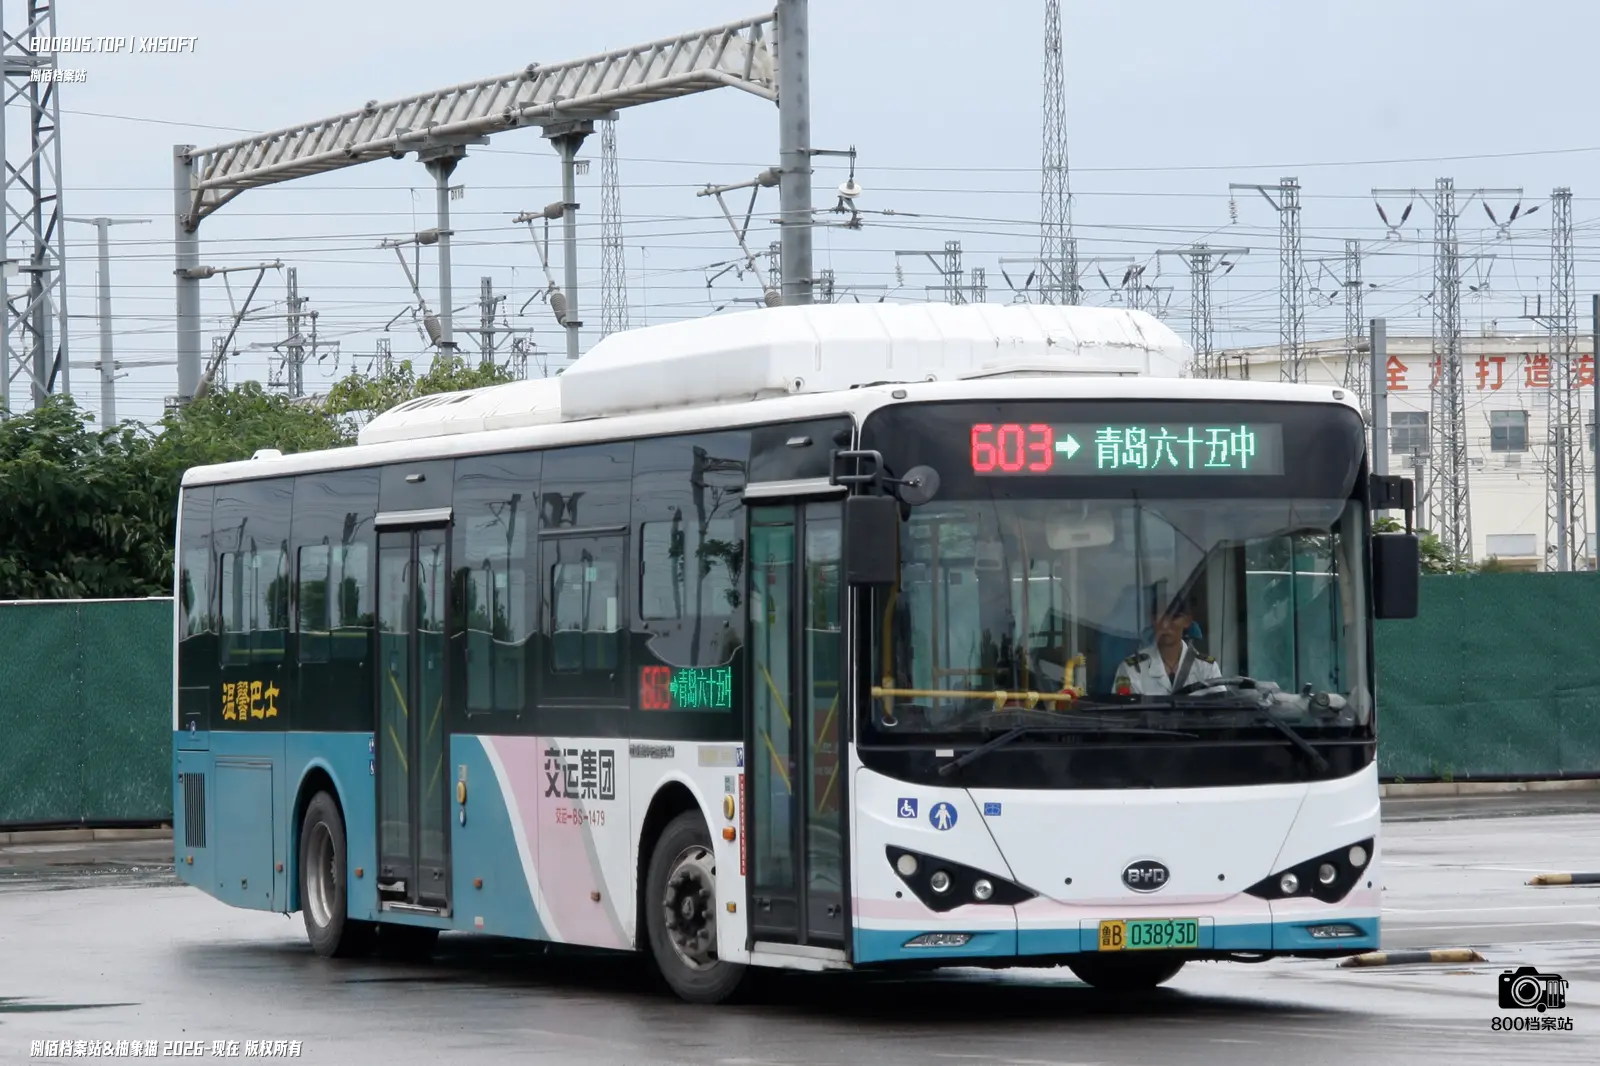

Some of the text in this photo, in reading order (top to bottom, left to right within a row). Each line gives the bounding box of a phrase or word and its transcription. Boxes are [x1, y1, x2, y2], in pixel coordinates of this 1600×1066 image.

[971, 423, 1255, 471] 603 青岛六十五中
[222, 680, 280, 720] 温馨巴士
[544, 747, 615, 800] 交运集团
[1127, 868, 1165, 883] BYD
